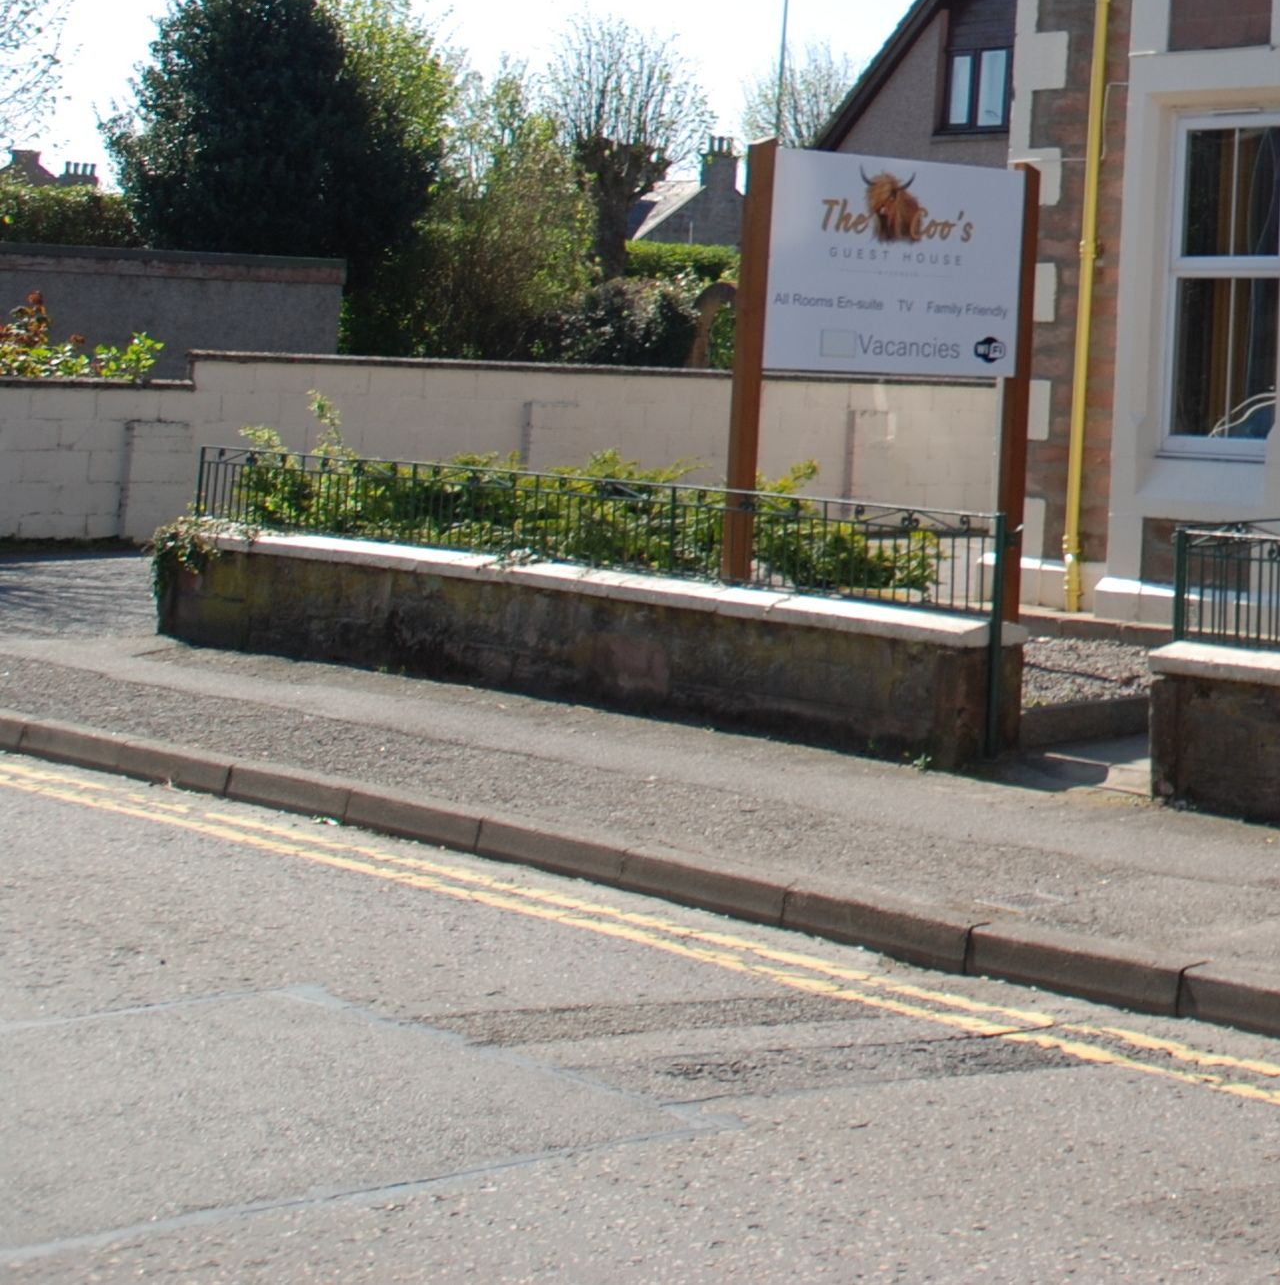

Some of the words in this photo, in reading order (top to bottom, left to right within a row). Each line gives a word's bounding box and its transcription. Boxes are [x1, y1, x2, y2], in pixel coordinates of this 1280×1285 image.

[820, 198, 874, 234] The
[910, 207, 974, 243] Coo's
[829, 247, 890, 261] GUEST
[902, 252, 963, 266] HOUSE
[774, 293, 790, 305] All
[793, 294, 833, 308] Rooms
[836, 296, 884, 311] En-suite
[897, 300, 914, 312] TV
[926, 301, 961, 317] Family
[965, 303, 1008, 319] Friendly
[858, 333, 960, 359] Vacancies
